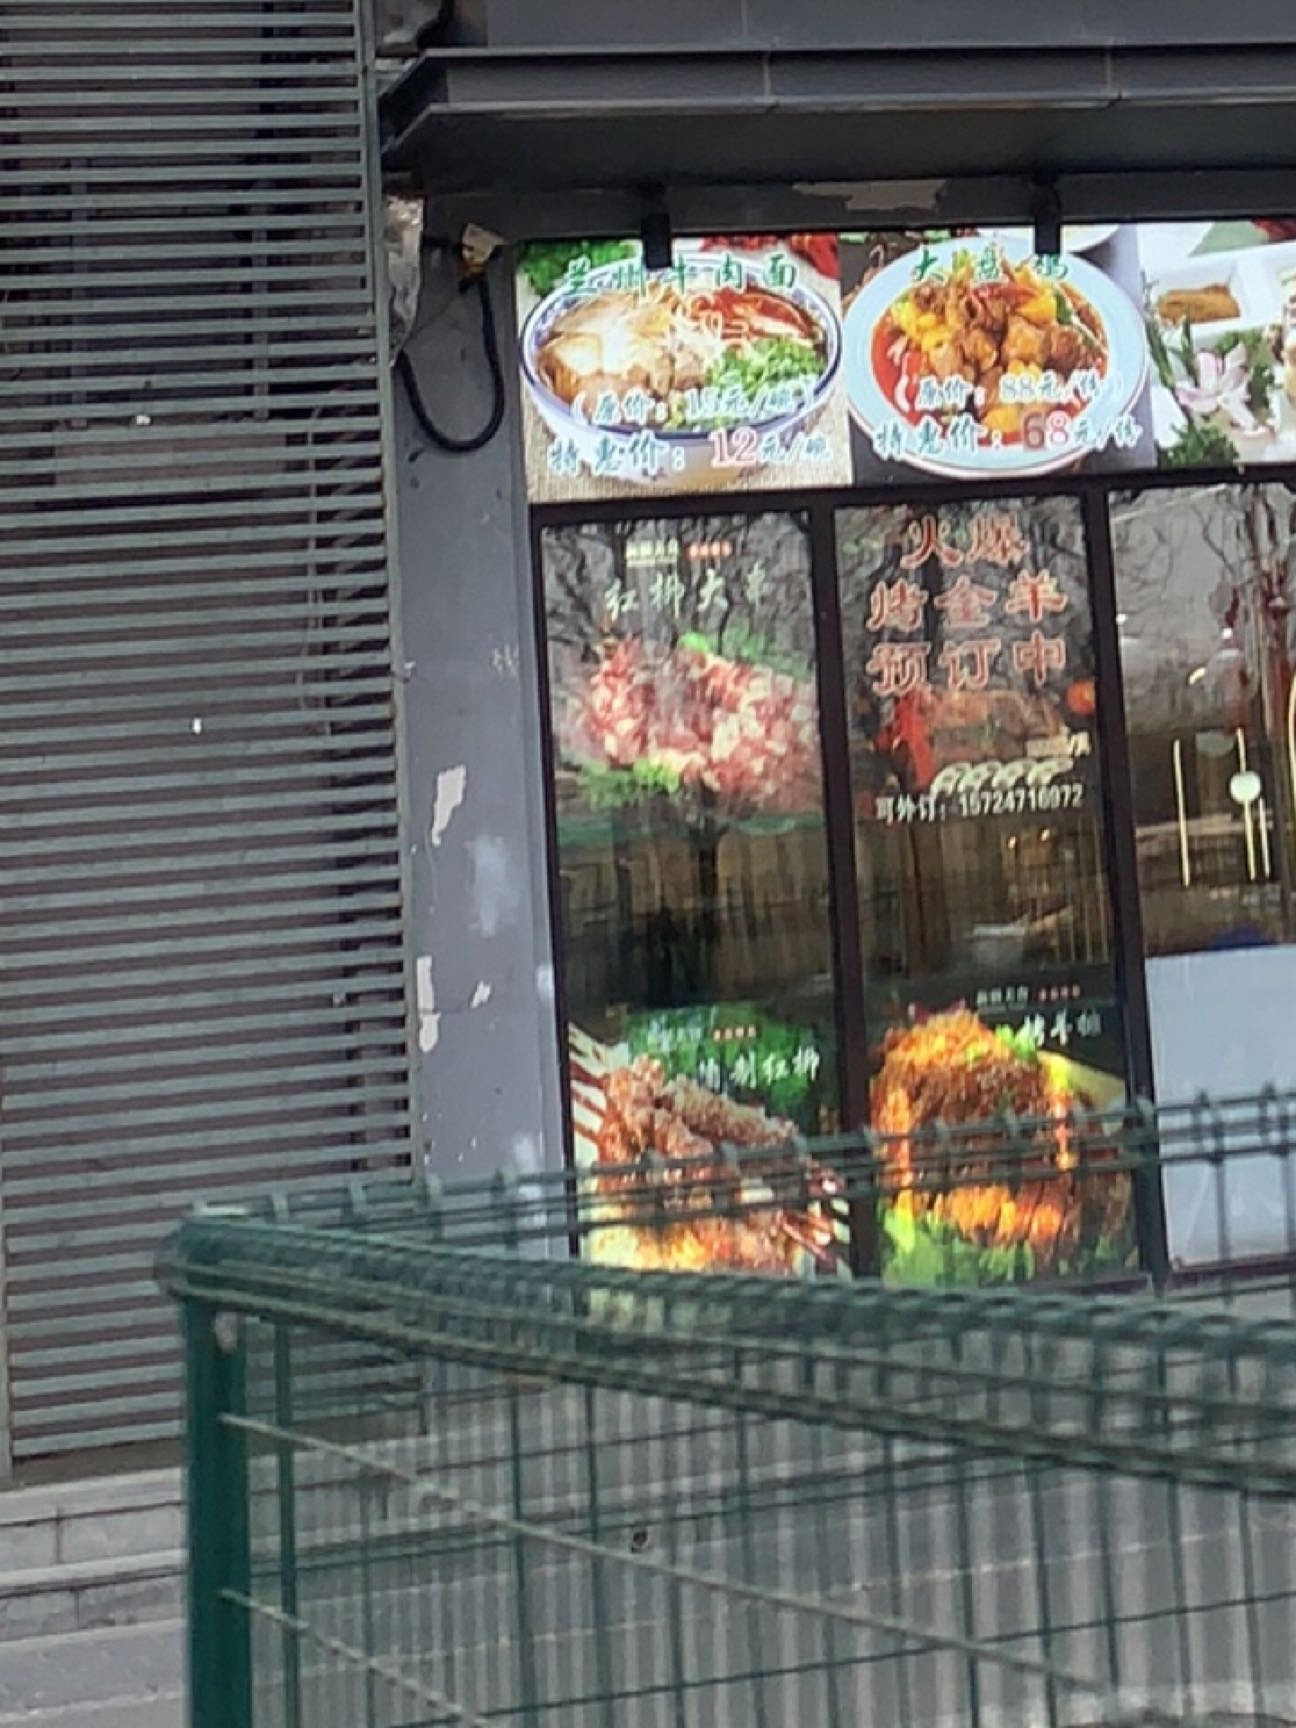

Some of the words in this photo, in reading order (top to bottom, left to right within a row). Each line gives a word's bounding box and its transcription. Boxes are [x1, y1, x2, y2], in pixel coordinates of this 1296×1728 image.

[899, 513, 1031, 570] 火爆
[865, 569, 1069, 633] 烤全羊
[866, 629, 1067, 697] 预订中
